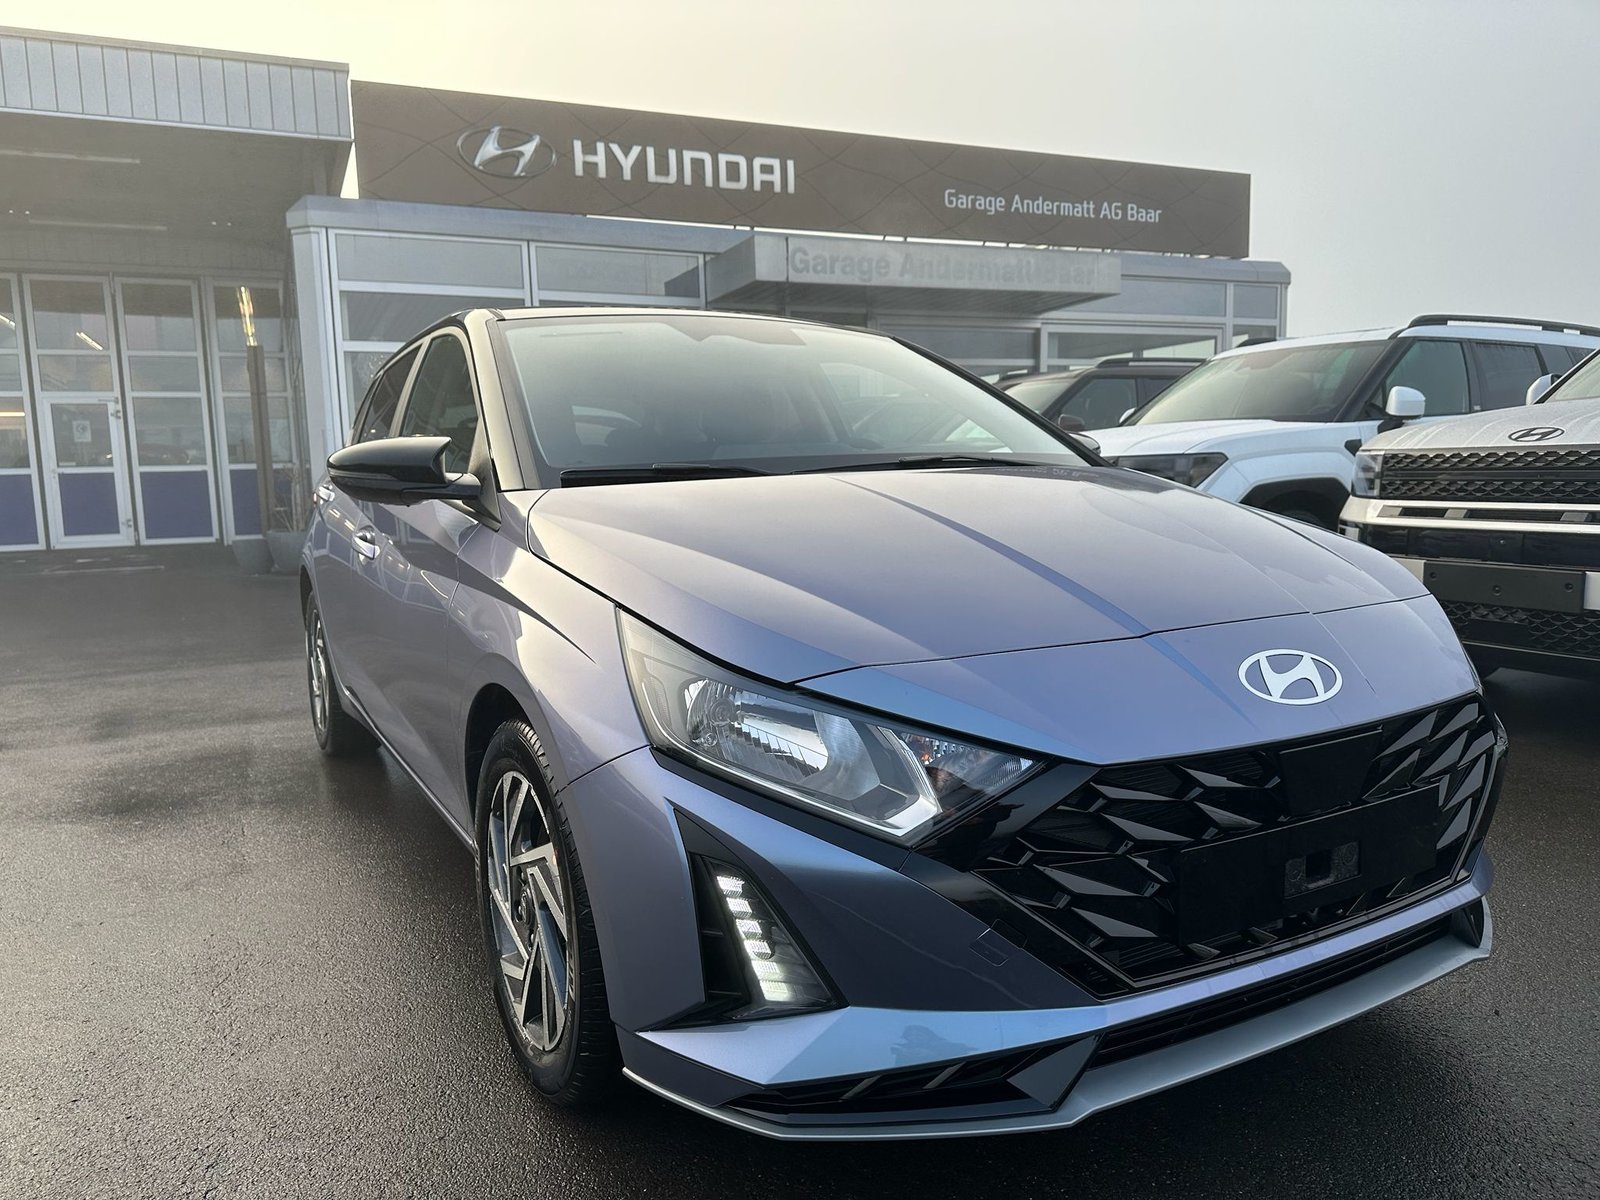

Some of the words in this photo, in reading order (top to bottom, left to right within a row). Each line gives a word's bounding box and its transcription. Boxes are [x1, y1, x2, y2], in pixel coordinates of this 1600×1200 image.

[573, 138, 795, 194] HYUNDAI
[944, 188, 1006, 215] Garage
[1010, 193, 1096, 219] Andermatt
[1099, 200, 1123, 220] AG
[1127, 203, 1162, 223] Baar
[790, 246, 891, 283] Garage
